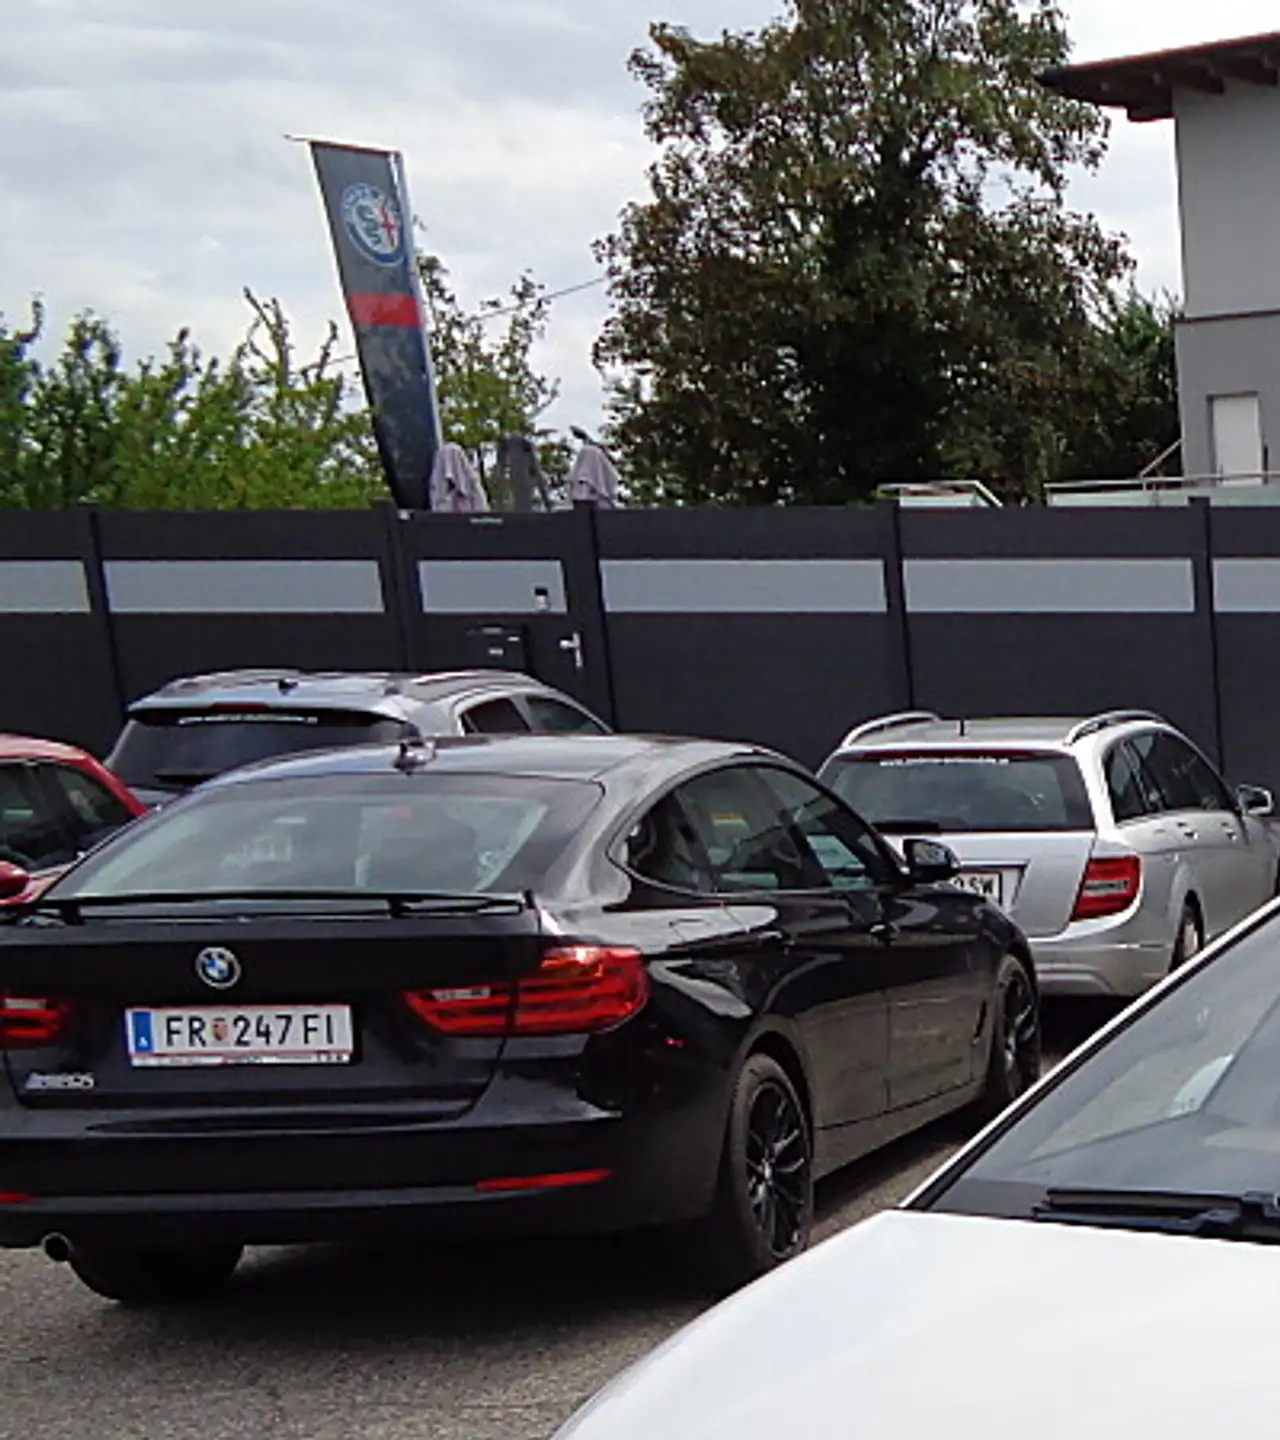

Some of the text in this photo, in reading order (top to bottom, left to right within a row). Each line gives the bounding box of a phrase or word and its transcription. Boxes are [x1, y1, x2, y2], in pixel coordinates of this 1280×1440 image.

[166, 1012, 335, 1048] FR 247 FI
